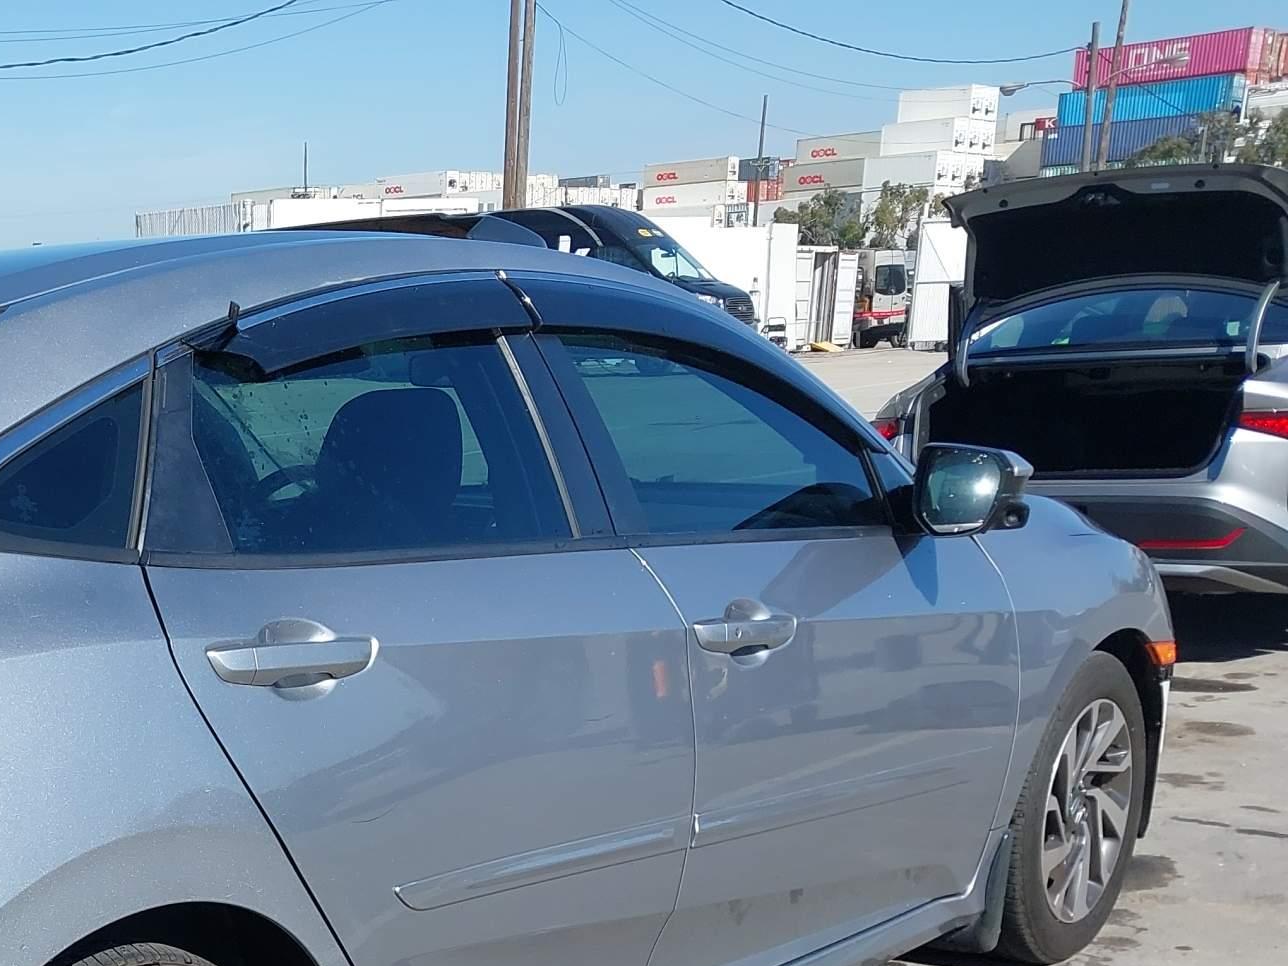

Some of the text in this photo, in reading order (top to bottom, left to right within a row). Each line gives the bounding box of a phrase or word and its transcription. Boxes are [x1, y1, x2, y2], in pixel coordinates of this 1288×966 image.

[811, 147, 837, 158] OOCL
[656, 172, 678, 181] OOCL
[798, 174, 824, 185] OOCL
[385, 185, 403, 194] OOCL
[655, 195, 677, 205] OOCL
